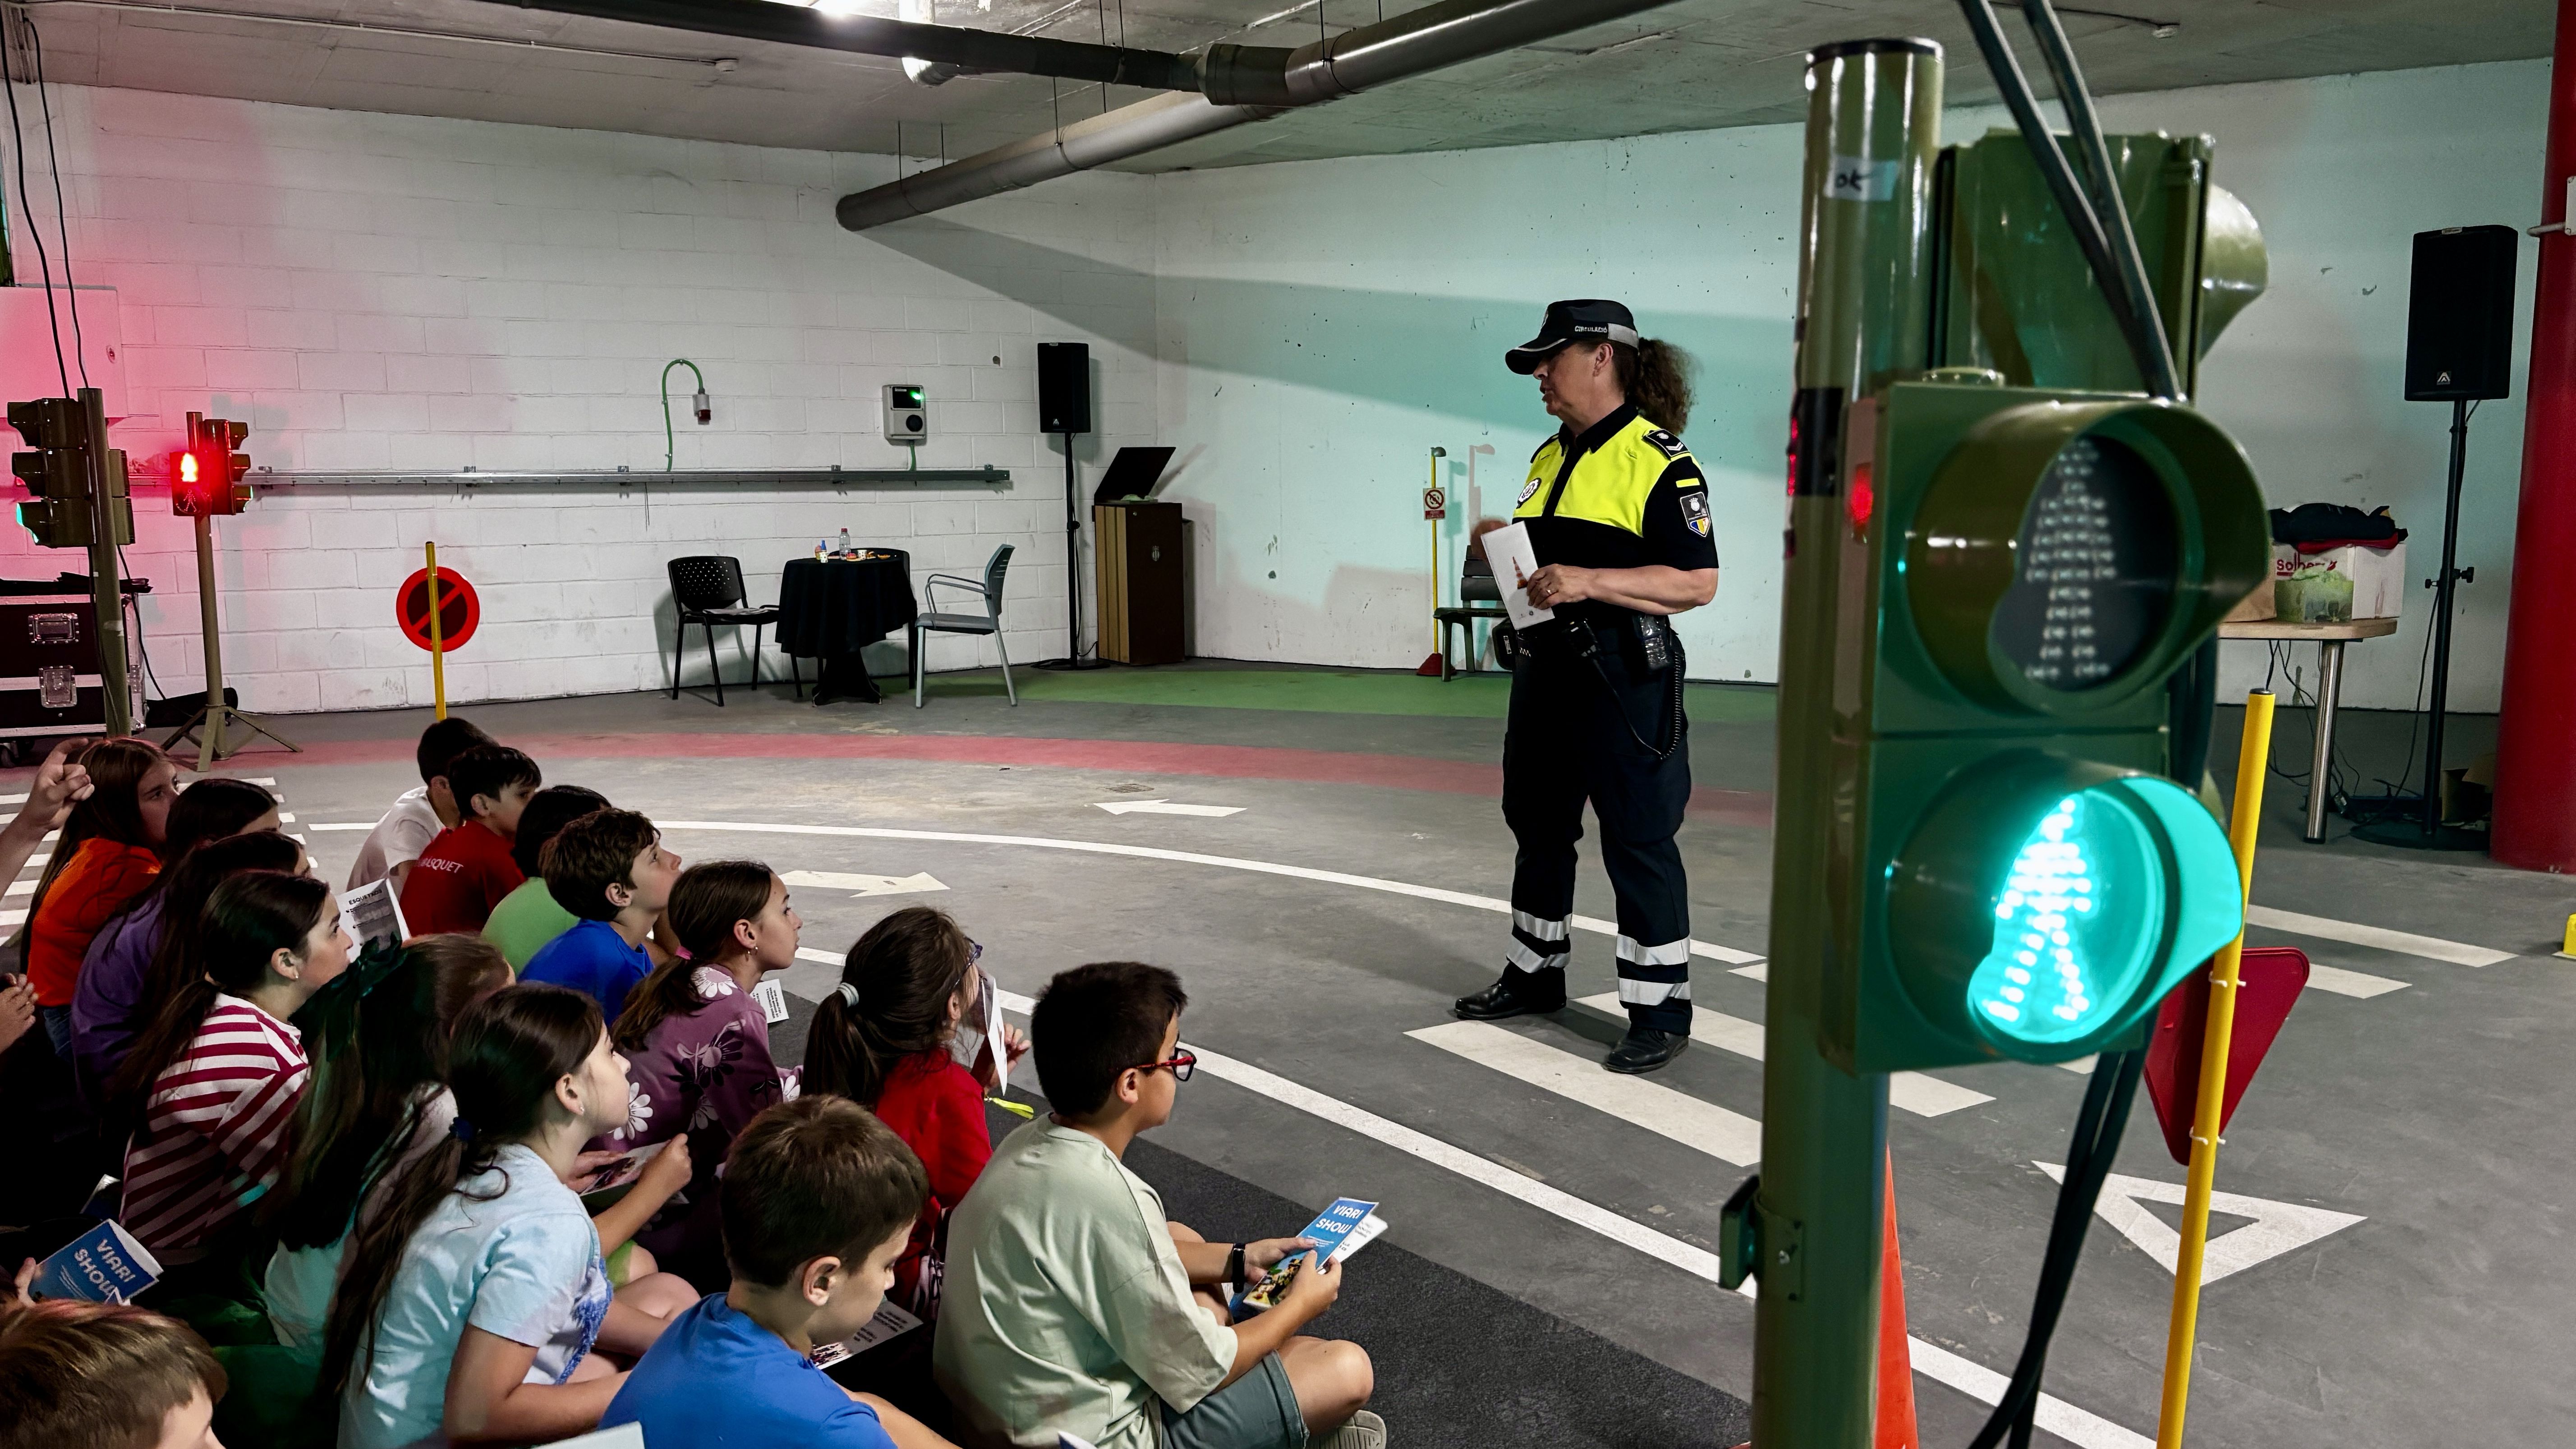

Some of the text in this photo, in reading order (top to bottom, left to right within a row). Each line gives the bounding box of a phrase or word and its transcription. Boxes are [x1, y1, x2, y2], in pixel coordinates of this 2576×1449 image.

[1333, 1205, 1364, 1219] VIARI
[1315, 1218, 1352, 1233] SHOW
[97, 1239, 136, 1282] VIARI
